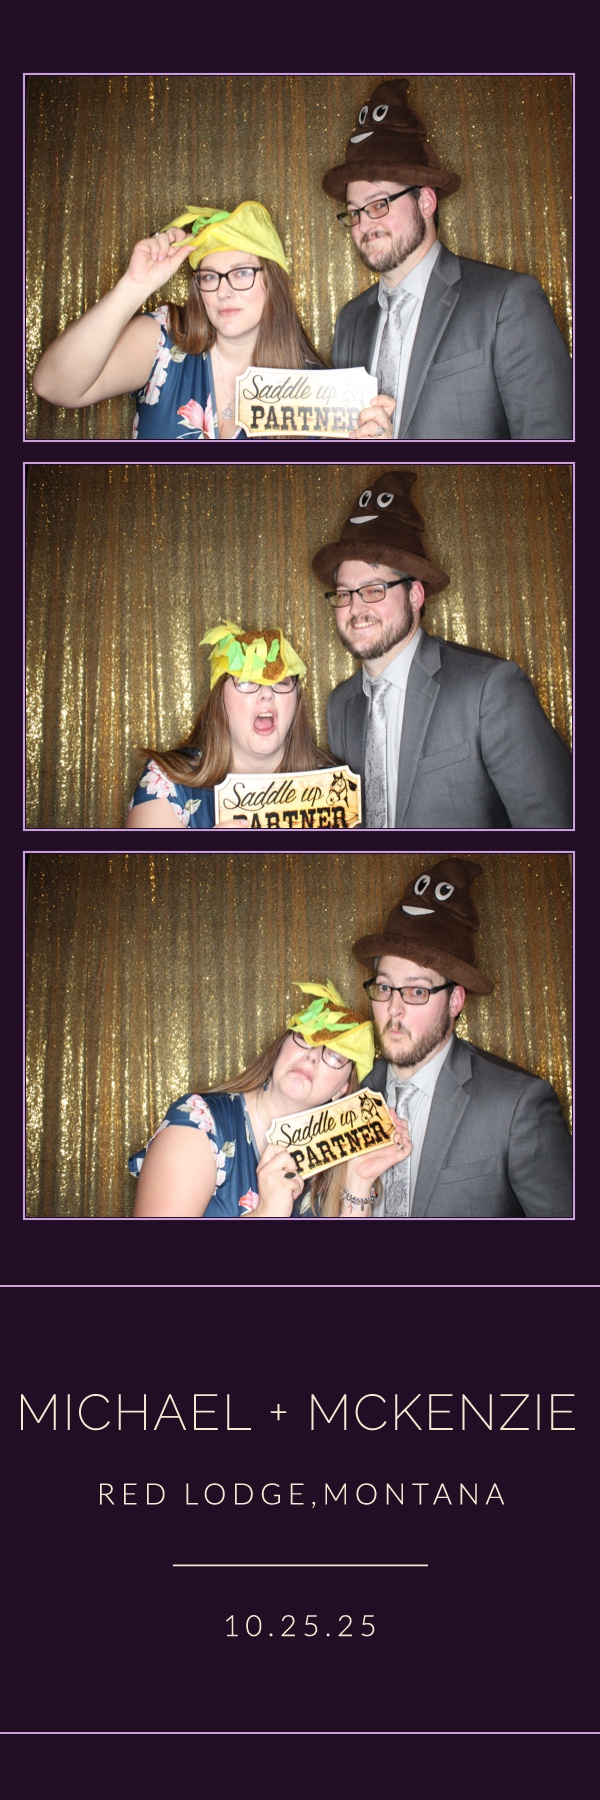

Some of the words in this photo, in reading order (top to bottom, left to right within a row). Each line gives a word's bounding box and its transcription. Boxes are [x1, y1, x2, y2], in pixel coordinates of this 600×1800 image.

[243, 375, 311, 403] Saddle
[315, 385, 339, 405] up
[223, 780, 297, 811] Saddle
[301, 787, 324, 807] up
[276, 1110, 336, 1149] Saddle
[340, 1110, 358, 1128] up
[290, 1121, 390, 1173] PARTNER
